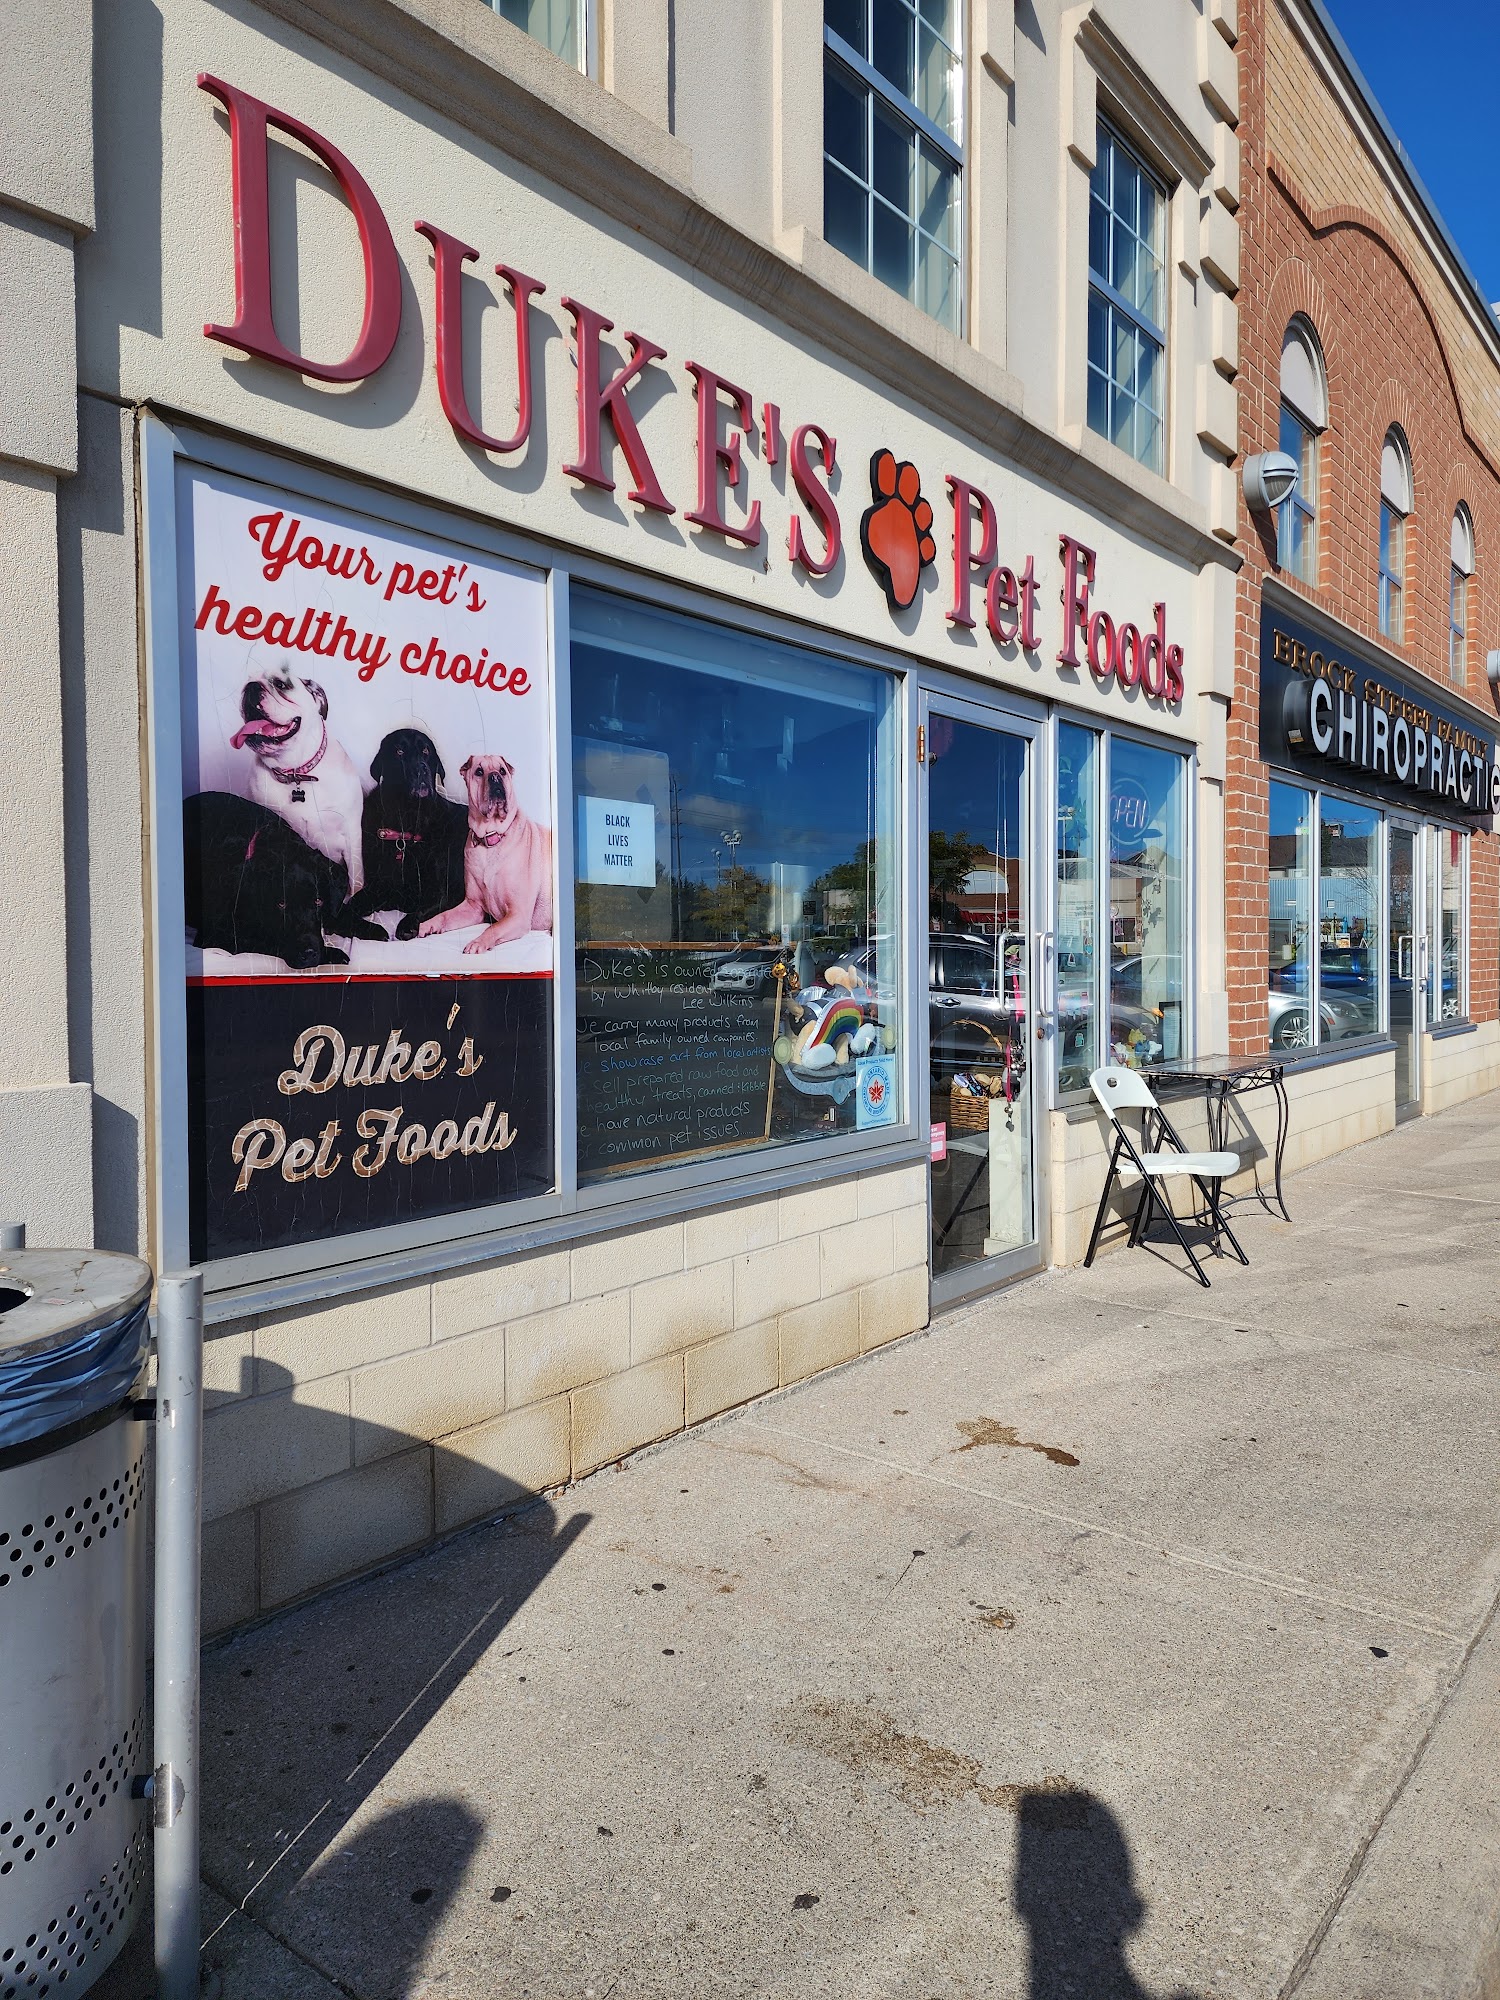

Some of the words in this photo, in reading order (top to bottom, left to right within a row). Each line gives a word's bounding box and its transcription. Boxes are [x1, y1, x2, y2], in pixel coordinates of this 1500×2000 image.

[197, 72, 841, 576] DUKE'S
[945, 474, 1042, 651] Pet
[1055, 533, 1184, 703] Foods
[247, 511, 382, 583] Your
[383, 561, 487, 612] pet's
[194, 584, 391, 682] healthy
[400, 637, 532, 696] choice
[1273, 628, 1357, 695] BROCK
[1364, 680, 1433, 733] STREET
[605, 814, 631, 828] BLACK
[608, 834, 629, 847] LIVES
[604, 853, 633, 867] MATTER
[655, 959, 669, 977] is
[674, 962, 716, 978] owned
[591, 984, 606, 1007] by
[614, 981, 664, 1004] Whitby
[682, 997, 705, 1010] Lee
[604, 1020, 640, 1036] carry
[645, 1018, 679, 1032] many
[683, 1014, 731, 1033] products
[736, 1013, 760, 1029] from
[277, 1003, 484, 1095] Duke's
[594, 1036, 629, 1053] local
[635, 1032, 672, 1049] family
[676, 1031, 710, 1044] owned
[600, 1056, 664, 1073] showcase
[669, 1048, 691, 1063] art
[694, 1046, 718, 1061] from
[723, 1047, 744, 1058] local
[746, 1047, 771, 1057] artists
[593, 1076, 620, 1095] sell
[626, 1068, 684, 1096] prepared
[688, 1070, 712, 1081] raw
[714, 1061, 740, 1078] food
[742, 1064, 760, 1077] and
[697, 1082, 734, 1098] canned
[596, 1117, 631, 1133] have
[636, 1106, 692, 1126] natural
[695, 1101, 751, 1127] products
[231, 1118, 343, 1193] Pet
[351, 1101, 518, 1178] Foods
[598, 1136, 662, 1155] common
[669, 1124, 693, 1151] pet
